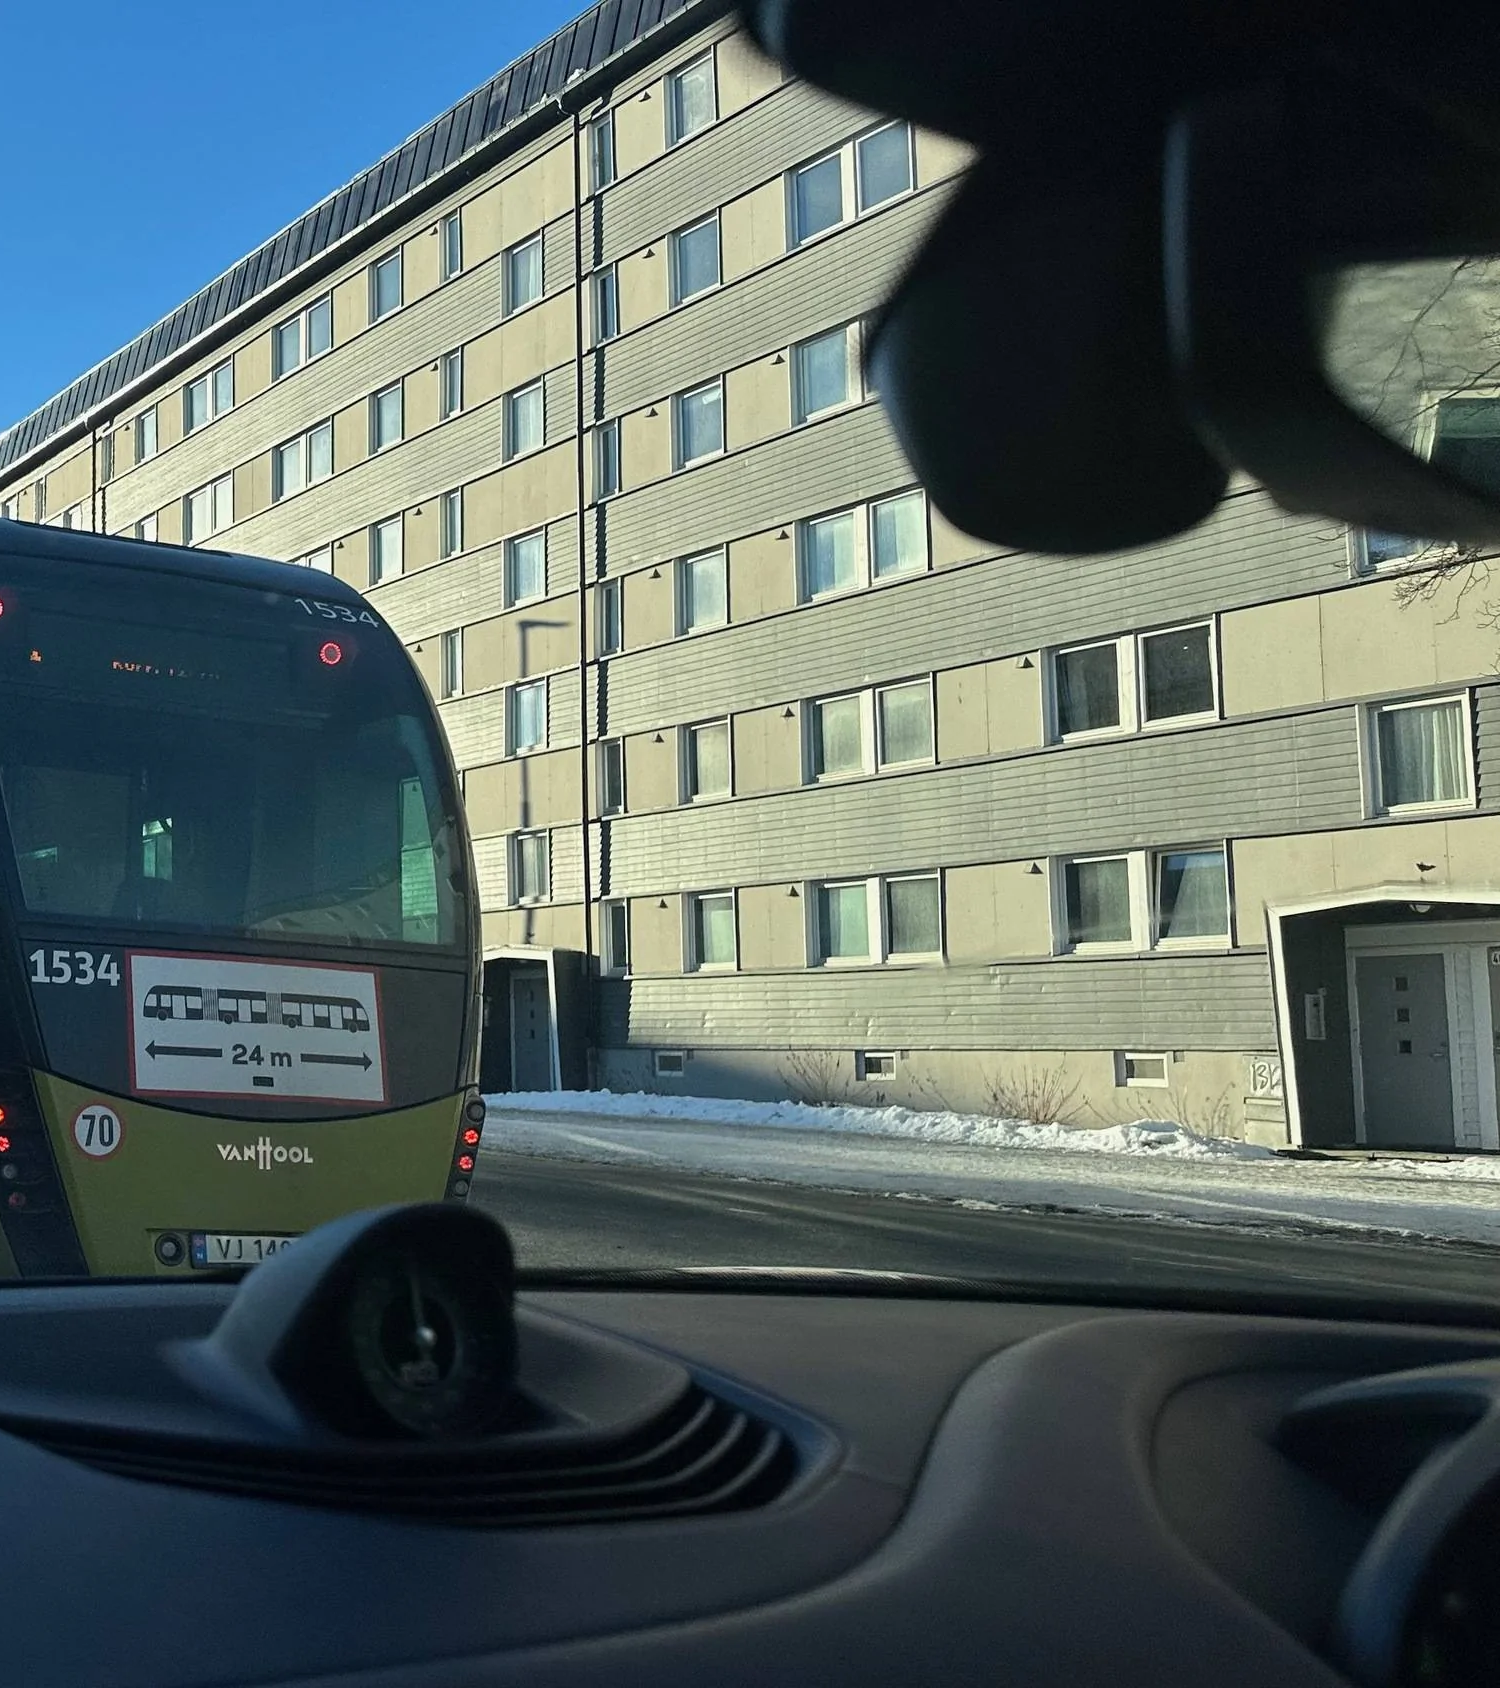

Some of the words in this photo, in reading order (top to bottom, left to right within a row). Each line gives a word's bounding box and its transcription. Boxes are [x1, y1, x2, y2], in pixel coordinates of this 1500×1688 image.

[294, 598, 380, 629] 1534
[29, 949, 121, 987] 1534
[232, 1043, 264, 1066] 24
[270, 1052, 293, 1068] m
[82, 1114, 114, 1147] 70
[216, 1238, 243, 1260] VJ
